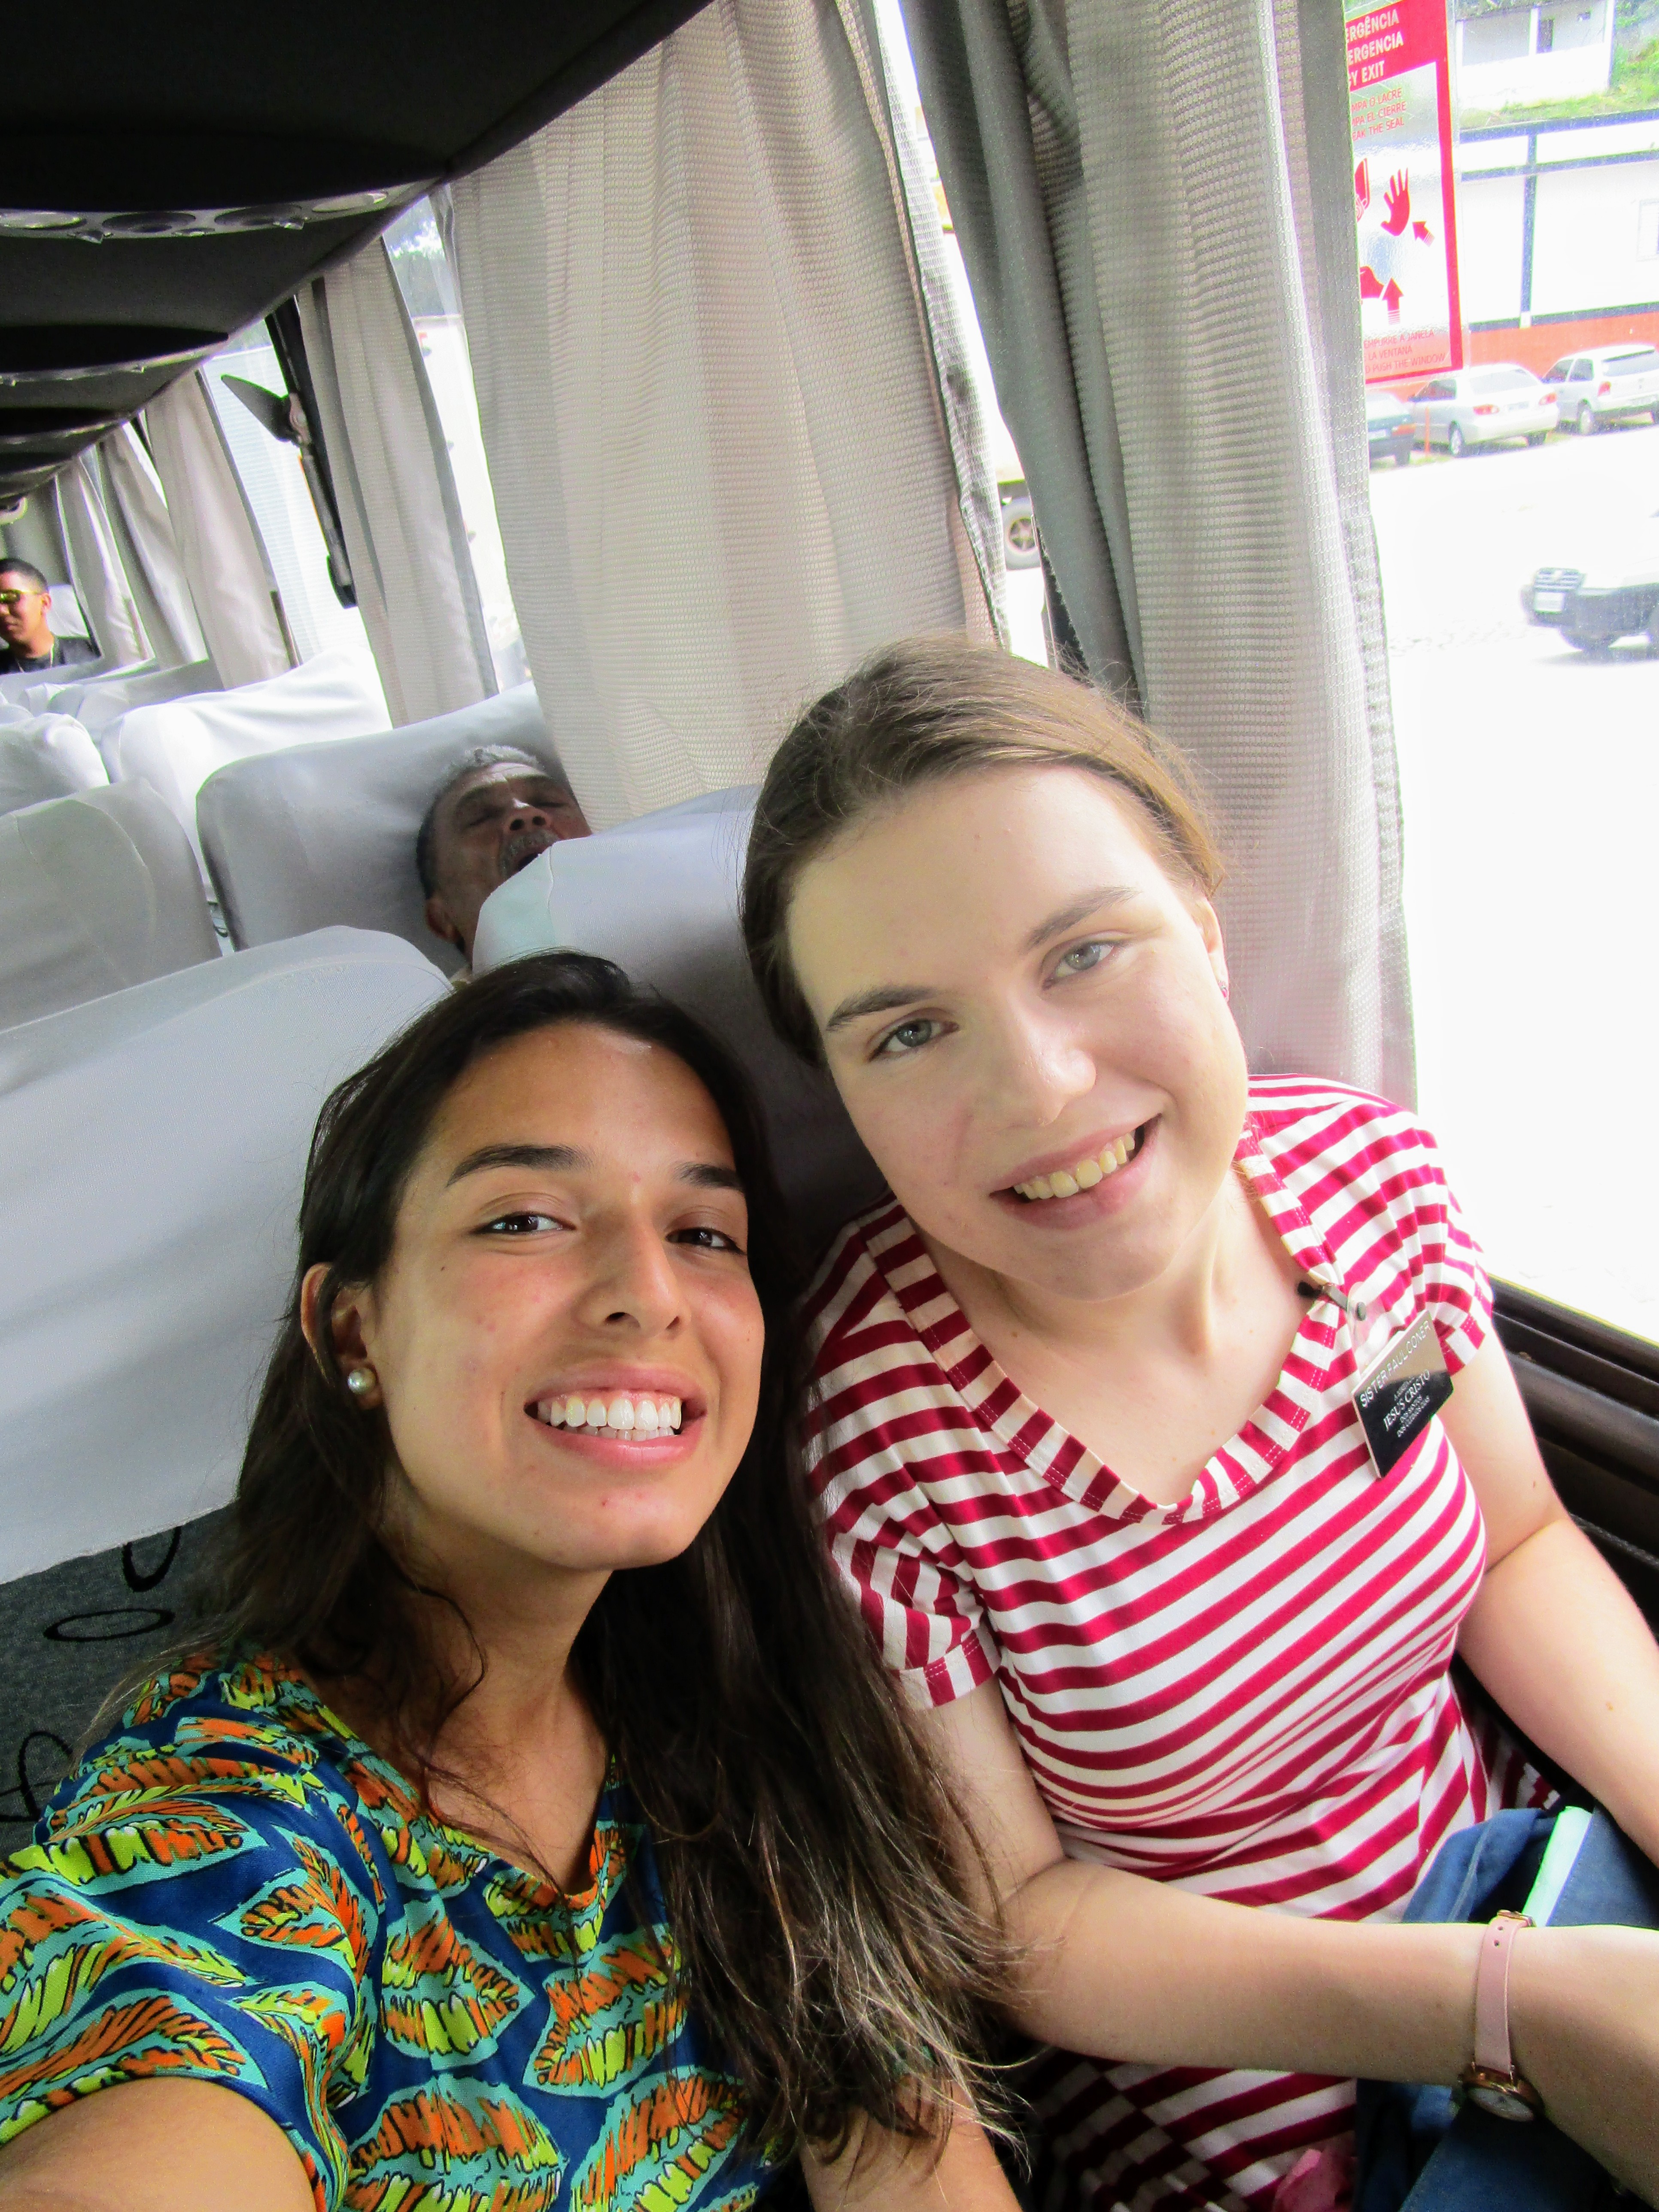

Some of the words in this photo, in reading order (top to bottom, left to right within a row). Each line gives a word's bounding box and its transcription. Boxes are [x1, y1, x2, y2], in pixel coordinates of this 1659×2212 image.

[1348, 31, 1404, 65] ERGENCIA
[1361, 60, 1385, 83] EXIT
[1369, 96, 1376, 106] O
[1378, 88, 1402, 104] LACRE
[1367, 112, 1376, 122] EL
[1378, 101, 1407, 118] CIERRE
[1369, 123, 1383, 135] THE
[1386, 117, 1404, 131] SEAL
[1364, 335, 1398, 349] EMPURRE
[1400, 333, 1404, 342] A
[1407, 329, 1434, 341] JANELA
[1368, 352, 1376, 361] LA
[1379, 345, 1413, 359] VENTANA
[1373, 363, 1392, 371] PUSH
[1395, 359, 1408, 368] THE
[1411, 353, 1445, 366] WINDOW
[1360, 1370, 1388, 1407] SISTER
[1383, 1398, 1405, 1432] JESUS
[1405, 1369, 1430, 1403] CRISTO
